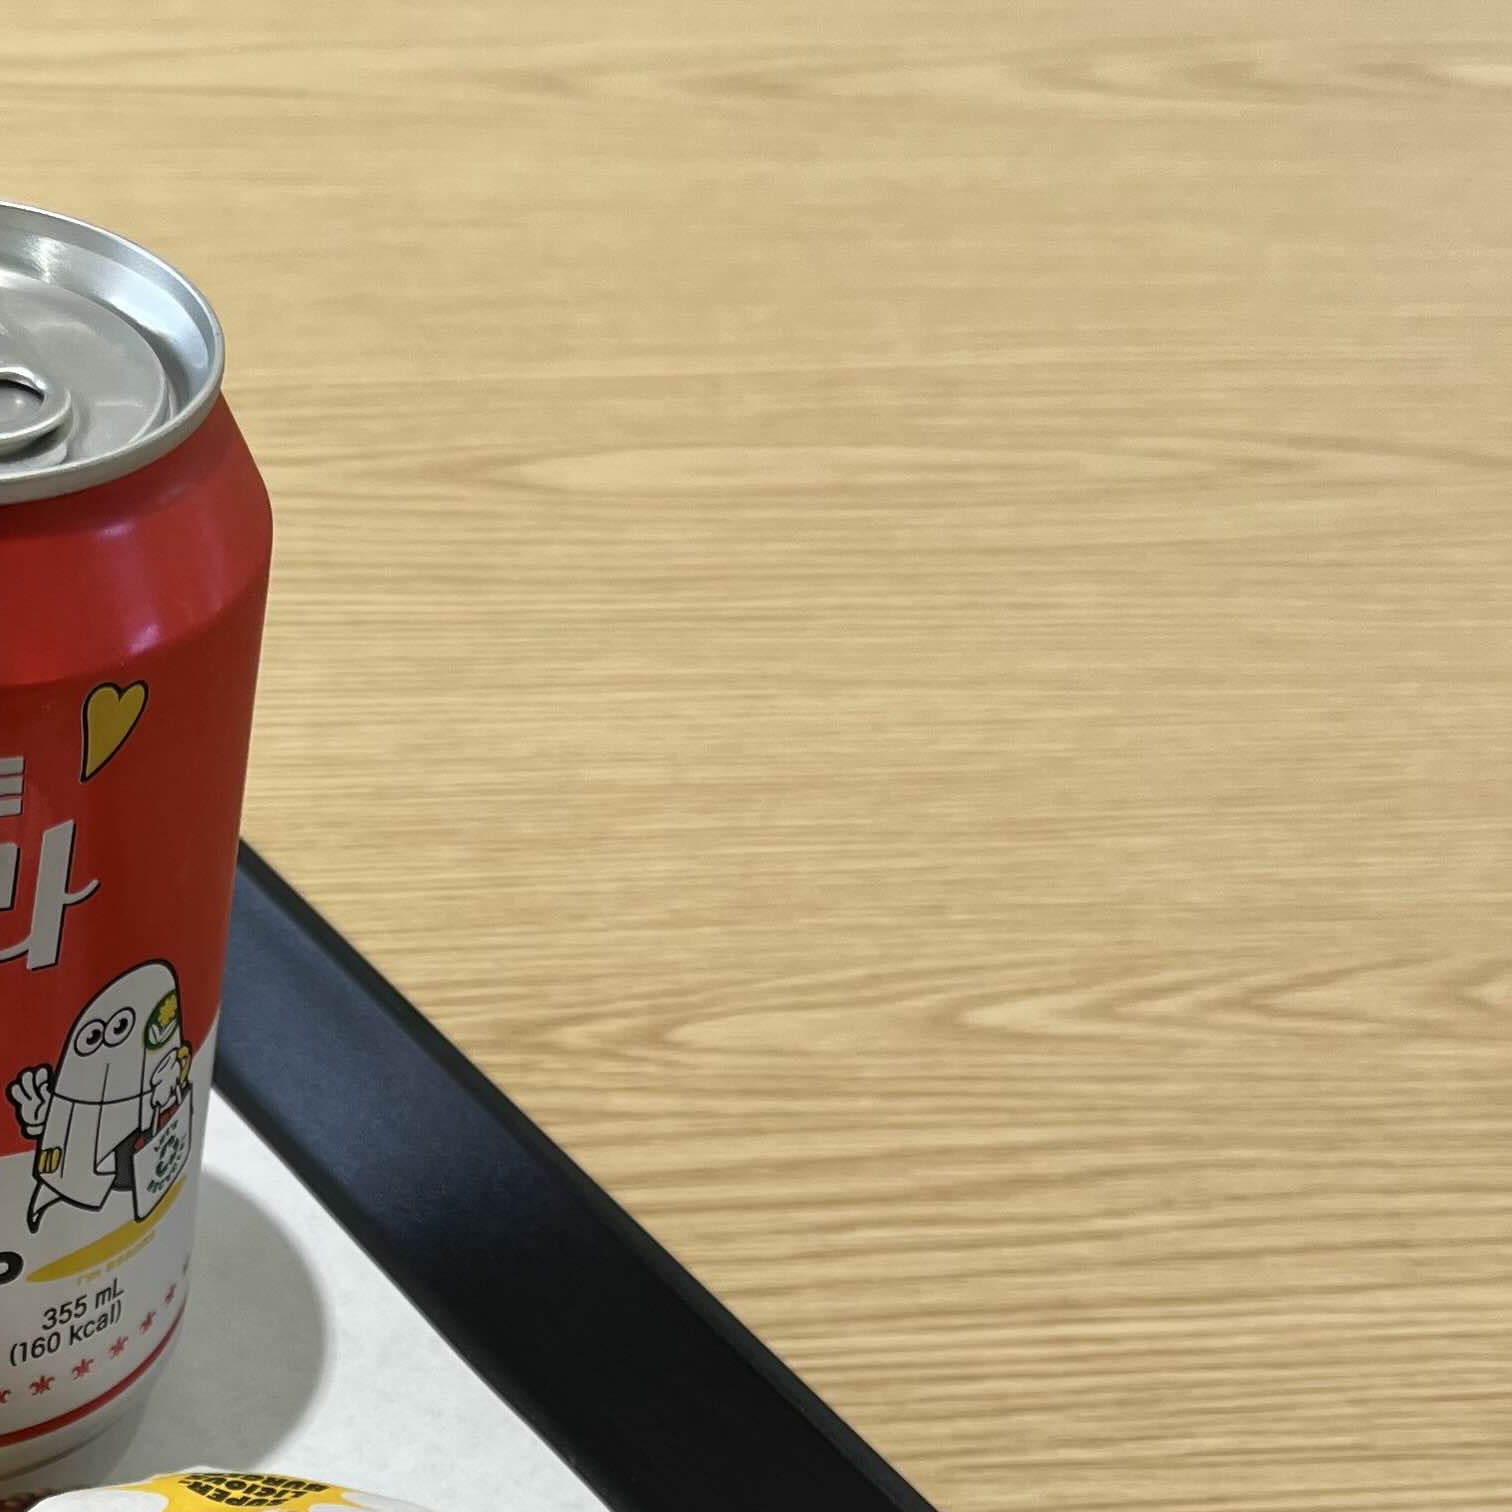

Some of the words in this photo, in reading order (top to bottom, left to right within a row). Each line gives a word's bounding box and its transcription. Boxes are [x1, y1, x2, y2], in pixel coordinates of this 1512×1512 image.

[9, 1332, 61, 1367] (160
[69, 1299, 123, 1345] kcal)
[42, 1294, 87, 1331] 355
[95, 1277, 124, 1309] mL
